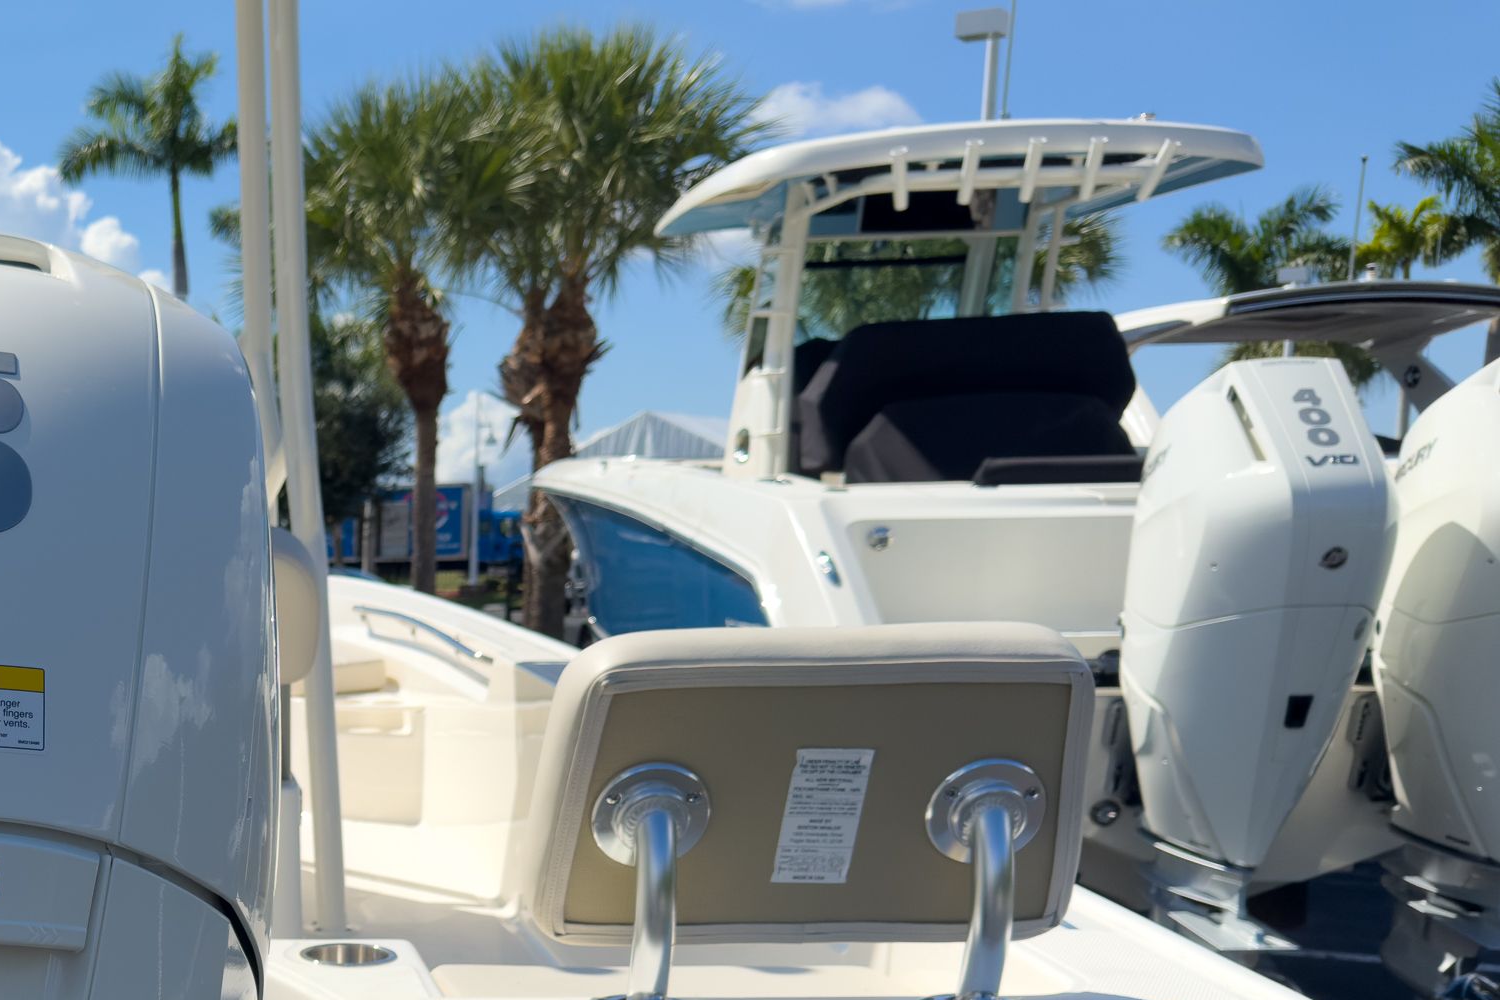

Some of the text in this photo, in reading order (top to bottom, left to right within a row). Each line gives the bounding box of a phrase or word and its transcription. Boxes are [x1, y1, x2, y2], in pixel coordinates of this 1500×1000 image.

[1293, 388, 1340, 447] 400
[3, 708, 34, 719] fingers
[3, 720, 30, 729] vents.
